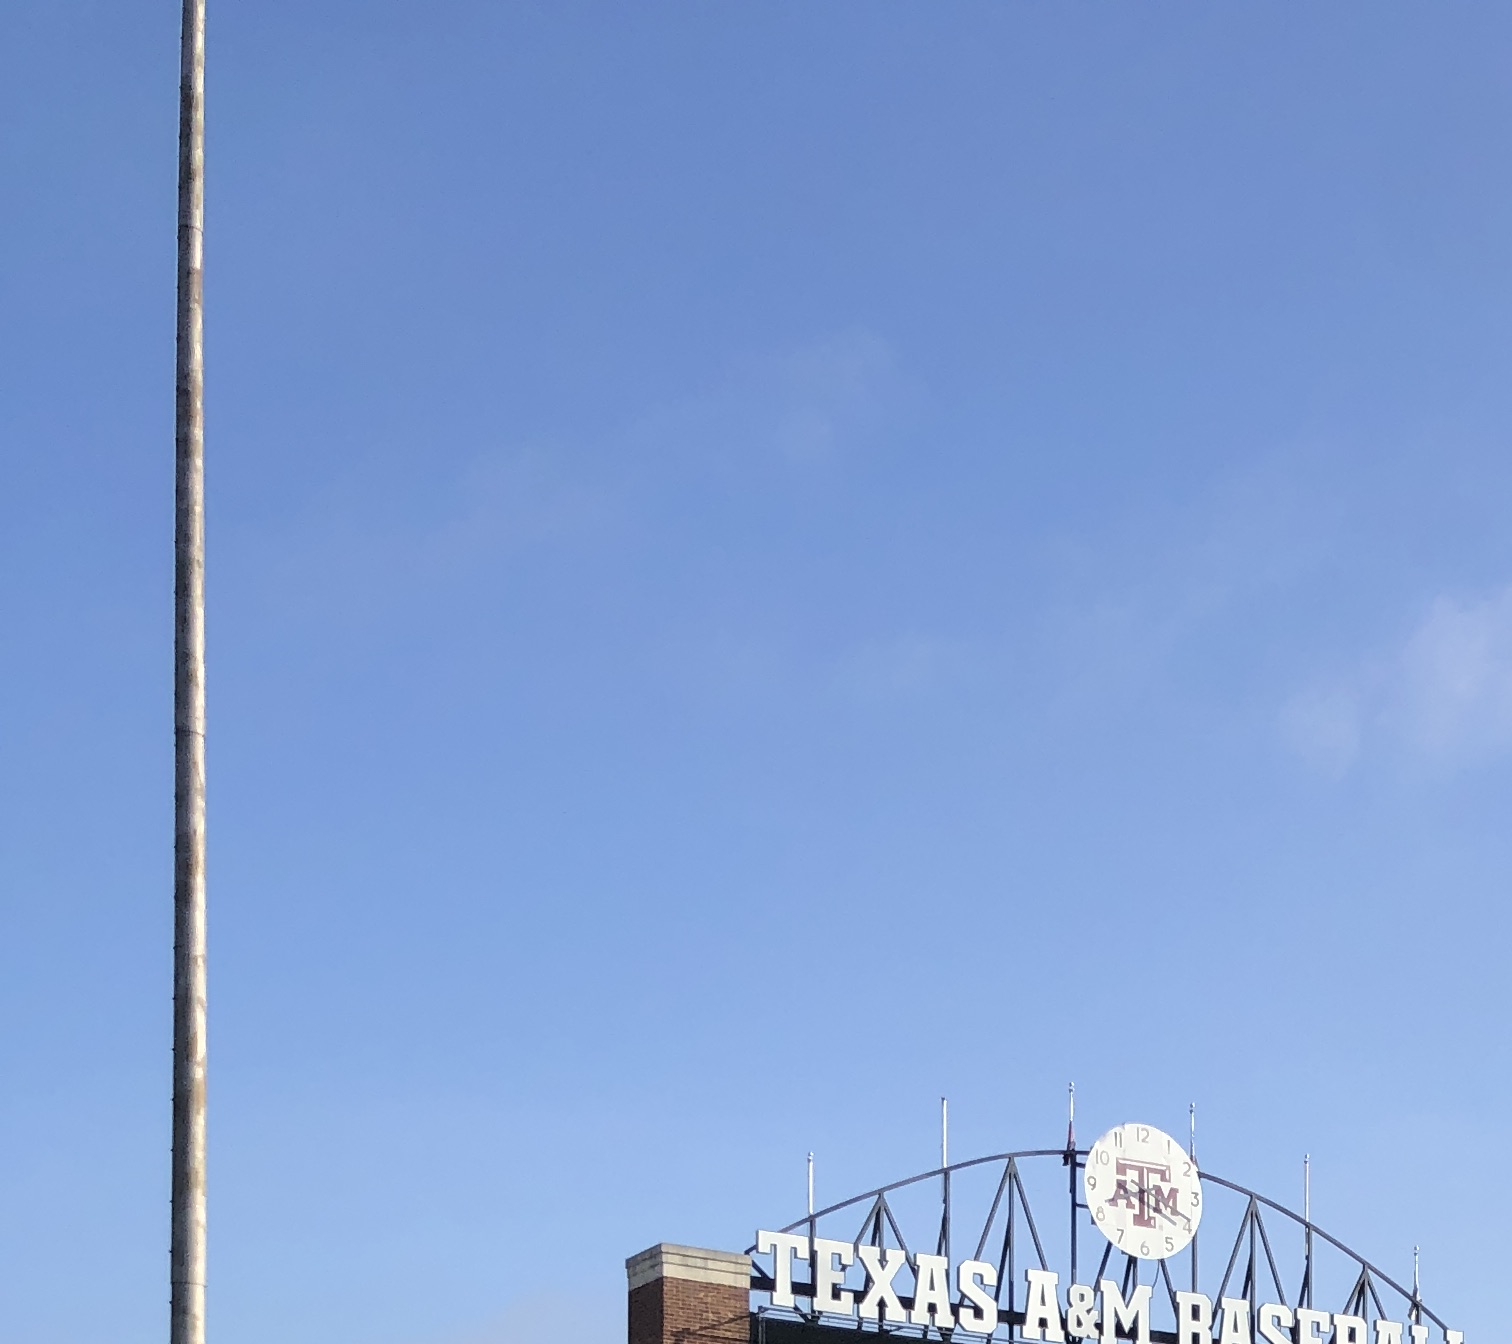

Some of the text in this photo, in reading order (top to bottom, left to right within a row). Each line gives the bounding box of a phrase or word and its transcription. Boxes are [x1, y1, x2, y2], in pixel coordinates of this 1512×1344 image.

[1114, 1131, 1123, 1148] 11
[1136, 1127, 1150, 1143] 12
[1167, 1140, 1171, 1154] 1
[1095, 1149, 1110, 1165] 10
[1182, 1162, 1192, 1177] 2
[1087, 1175, 1097, 1190] 9
[1190, 1192, 1200, 1207] 3
[1095, 1206, 1106, 1221] 8
[1182, 1220, 1192, 1234] 4
[1116, 1228, 1125, 1244] 7
[1140, 1241, 1150, 1256] 6
[1164, 1236, 1174, 1252] 5
[756, 1229, 998, 1334] TEXAS
